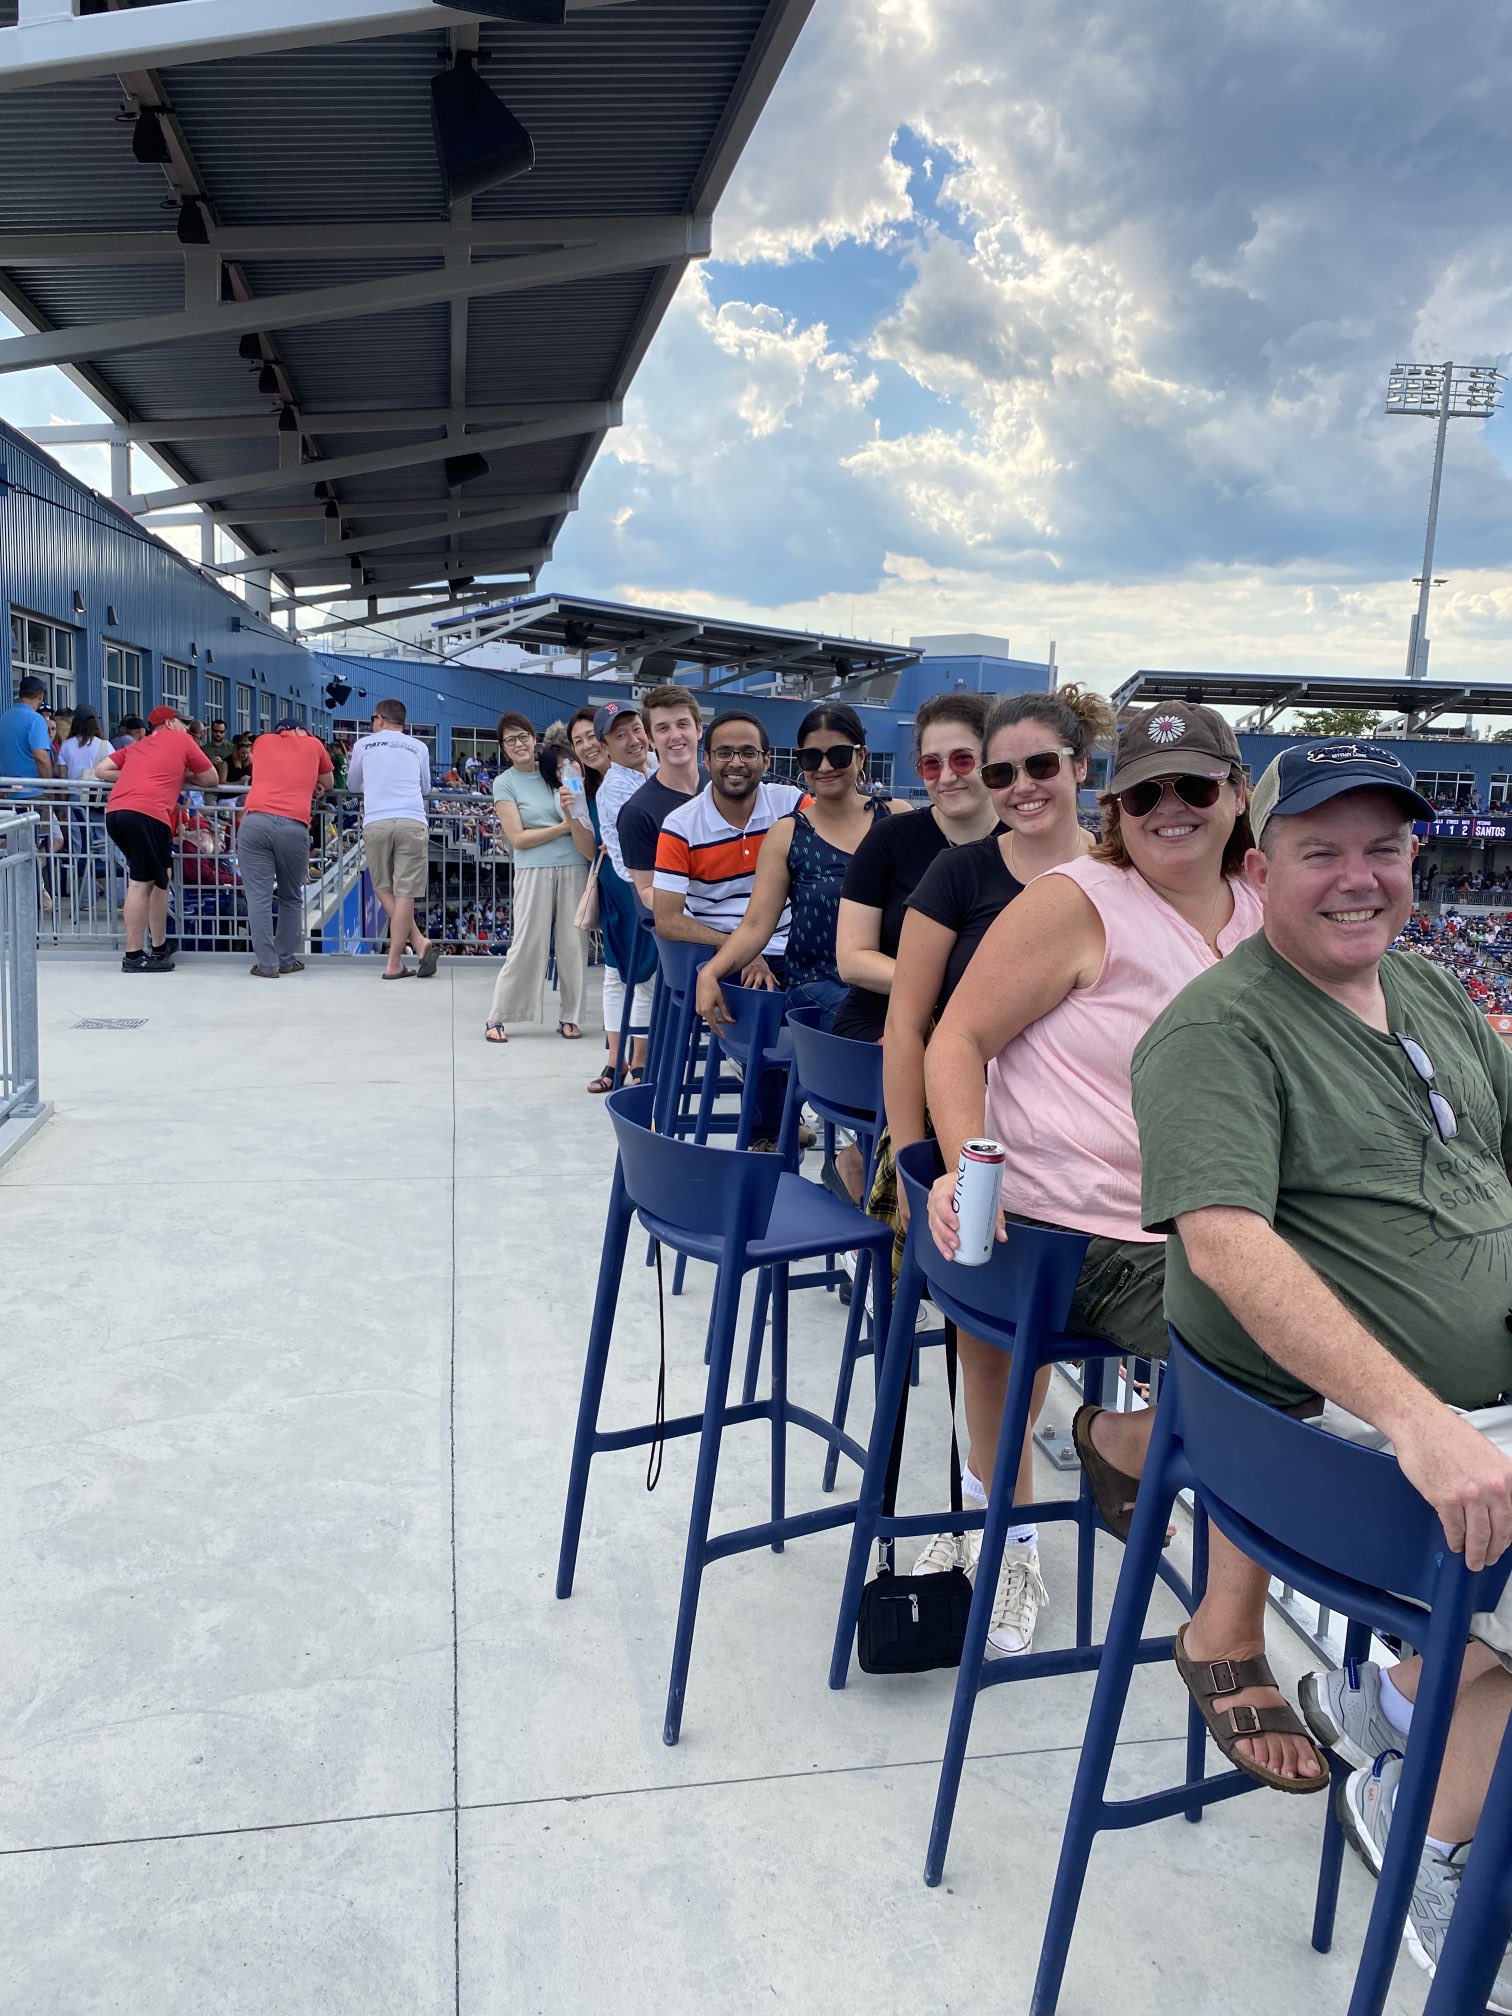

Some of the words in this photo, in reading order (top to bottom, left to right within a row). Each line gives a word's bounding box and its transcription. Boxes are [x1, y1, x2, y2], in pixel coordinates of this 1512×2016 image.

[1435, 824, 1440, 834] 1
[1449, 825, 1455, 835] 1
[1461, 825, 1468, 836] 2
[1475, 826, 1506, 837] SANTOS
